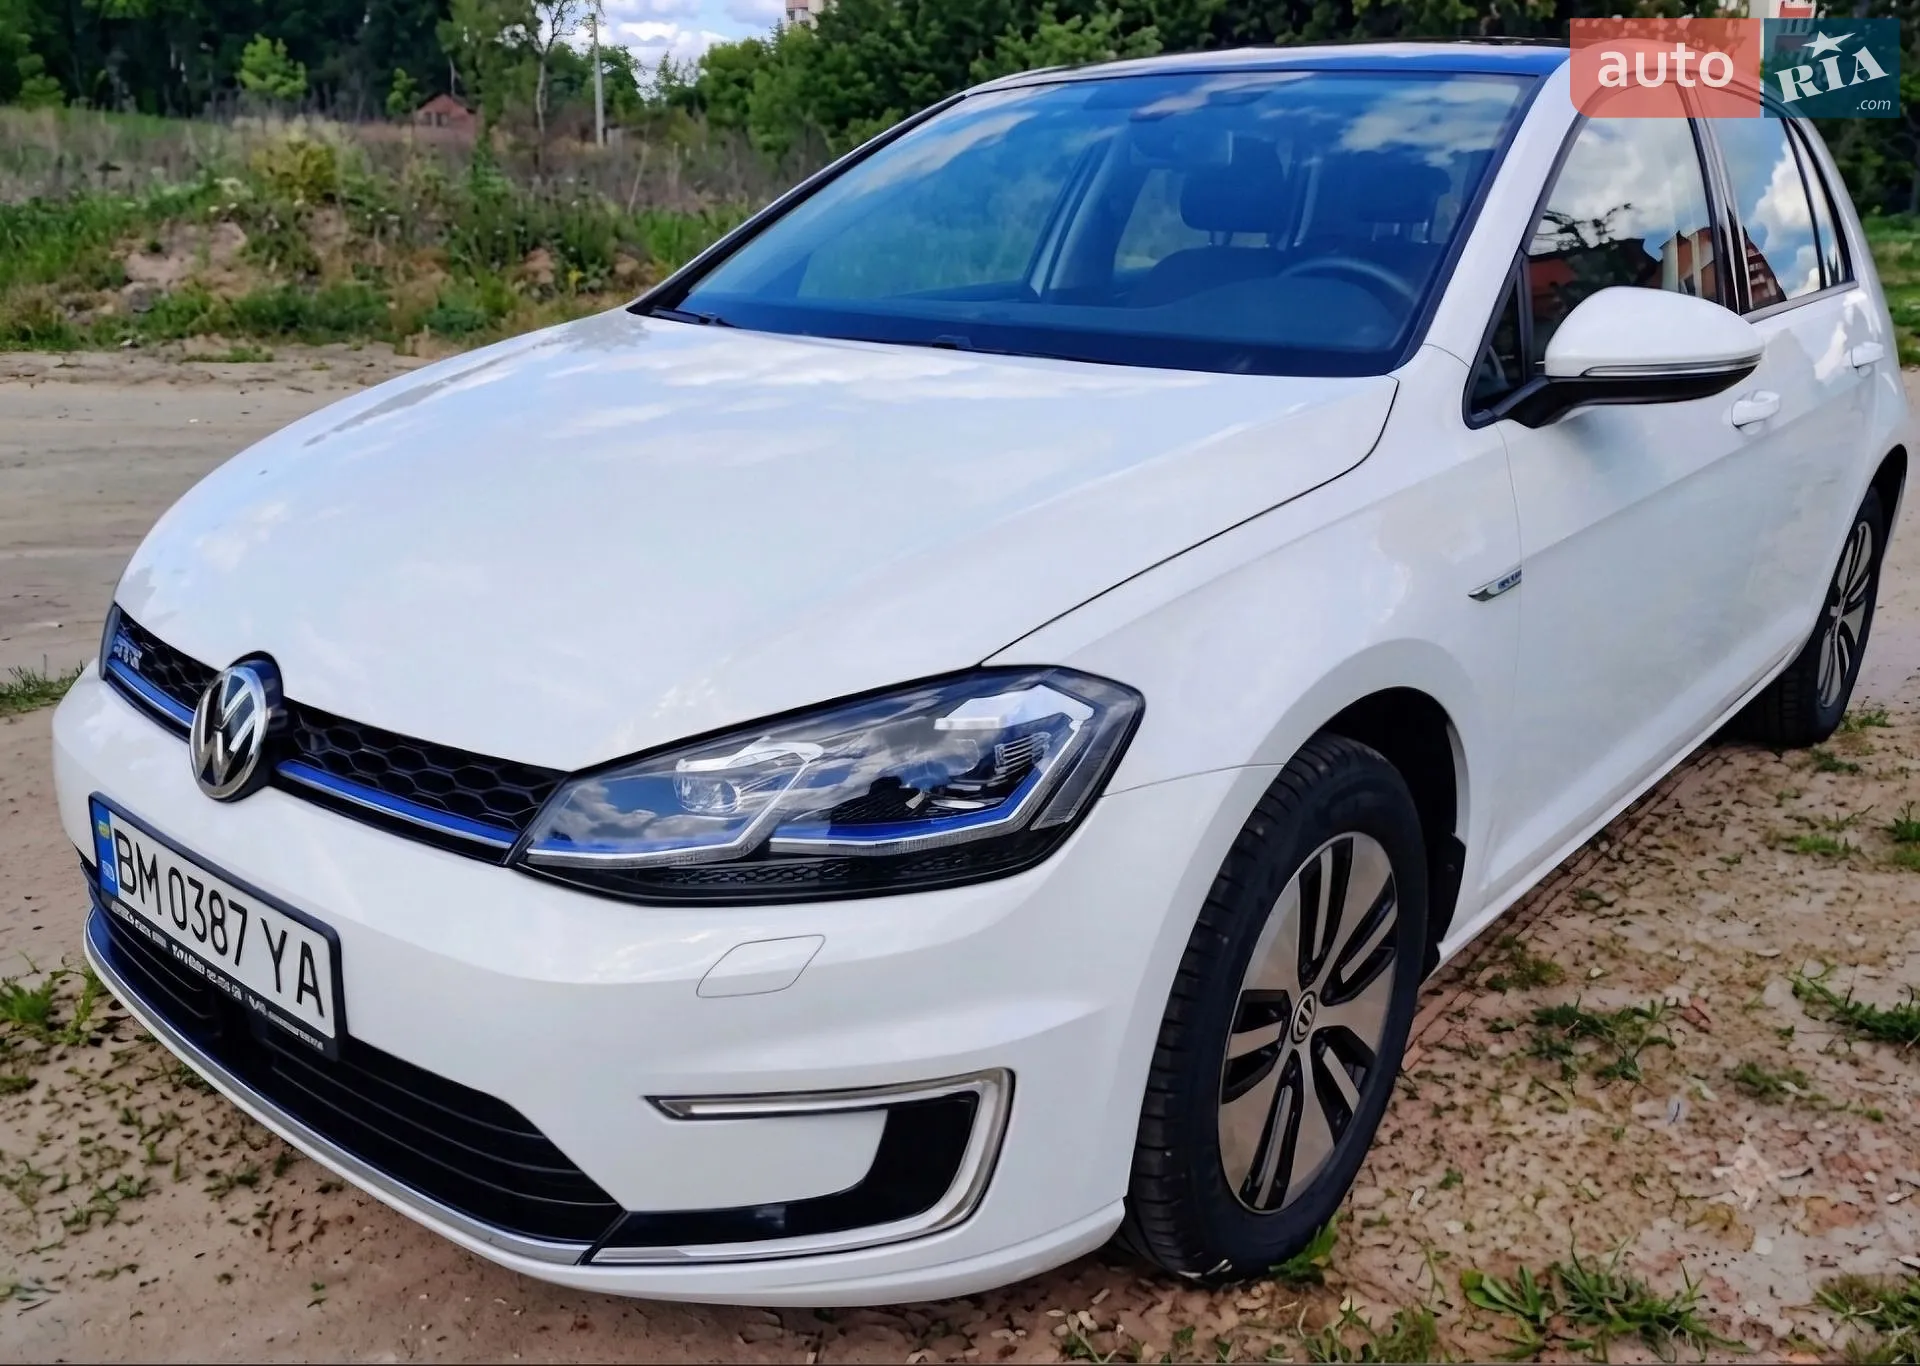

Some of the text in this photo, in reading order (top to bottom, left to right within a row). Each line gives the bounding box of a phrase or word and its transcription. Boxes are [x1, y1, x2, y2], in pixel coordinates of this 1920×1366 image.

[114, 828, 162, 916] BM
[168, 866, 248, 967] 0387
[260, 917, 325, 1018] YA
